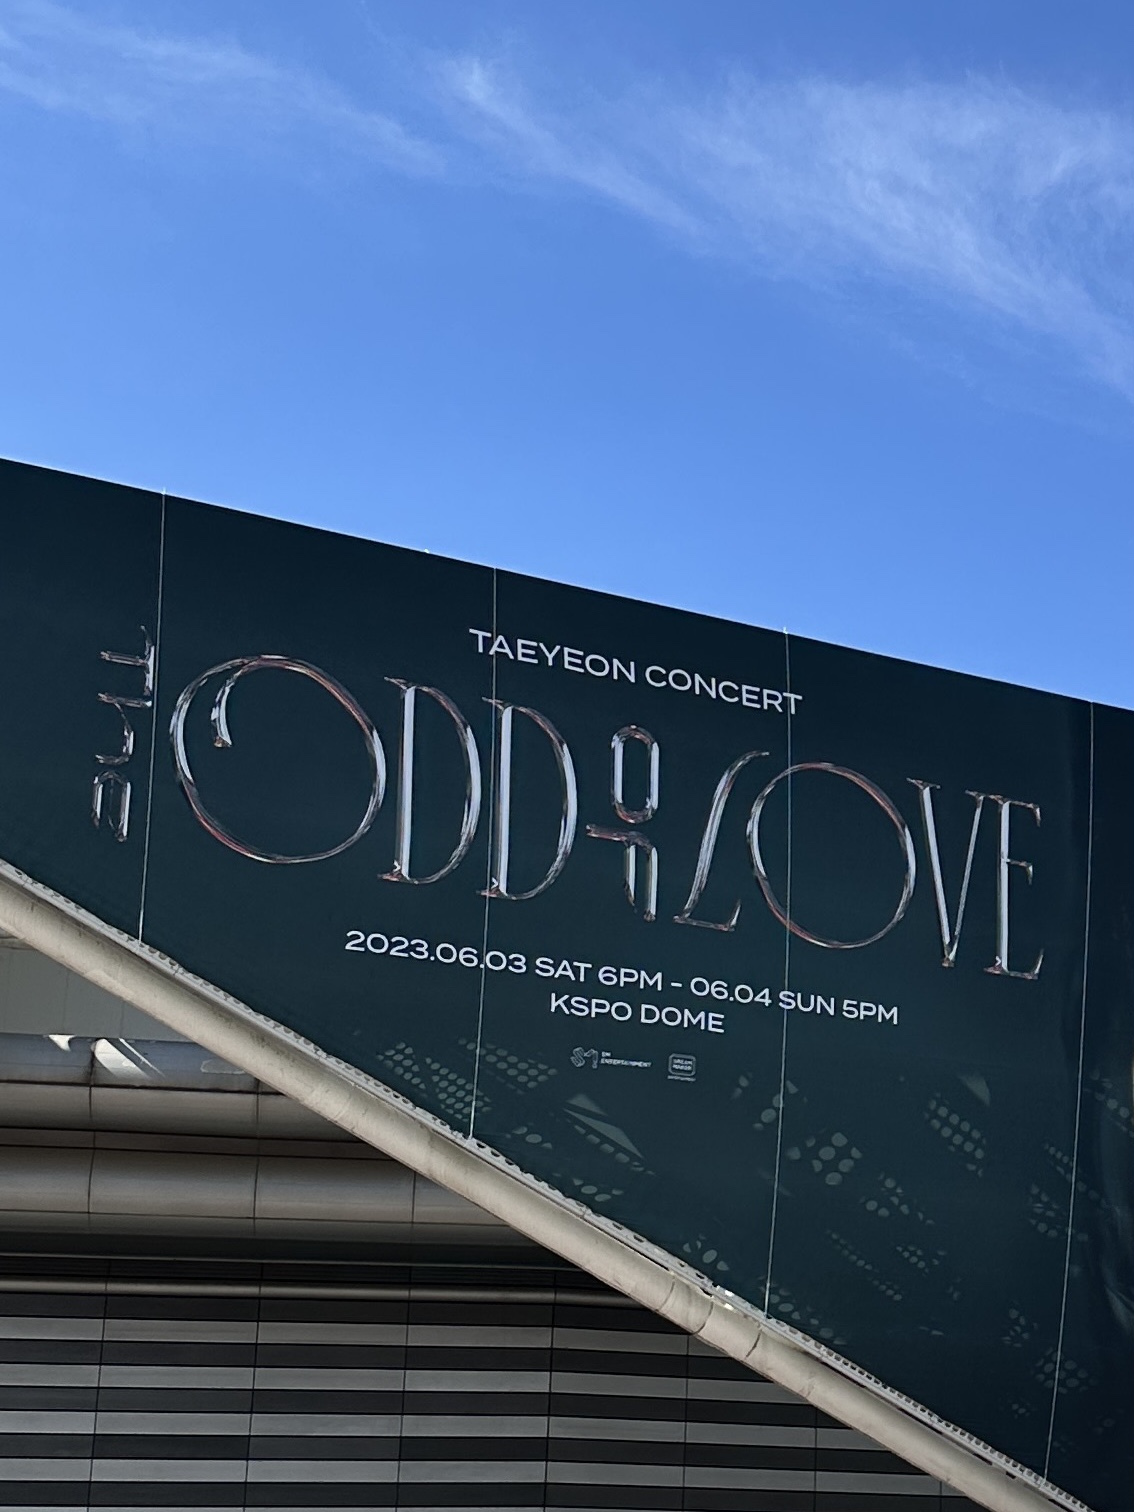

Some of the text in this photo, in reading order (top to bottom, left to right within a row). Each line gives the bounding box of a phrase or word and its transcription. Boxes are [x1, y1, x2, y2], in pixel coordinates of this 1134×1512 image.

[469, 627, 803, 715] TAEYEON CONCERT
[169, 653, 578, 901] ODD
[673, 750, 1044, 981] LOVE
[345, 930, 528, 974] 2023.06.03
[535, 957, 592, 983] SAT
[598, 965, 663, 991] 6PM
[690, 976, 773, 1007] 06.04
[778, 989, 835, 1016] SUN
[842, 999, 899, 1025] 5PM
[549, 992, 726, 1034] KSPO DOME
